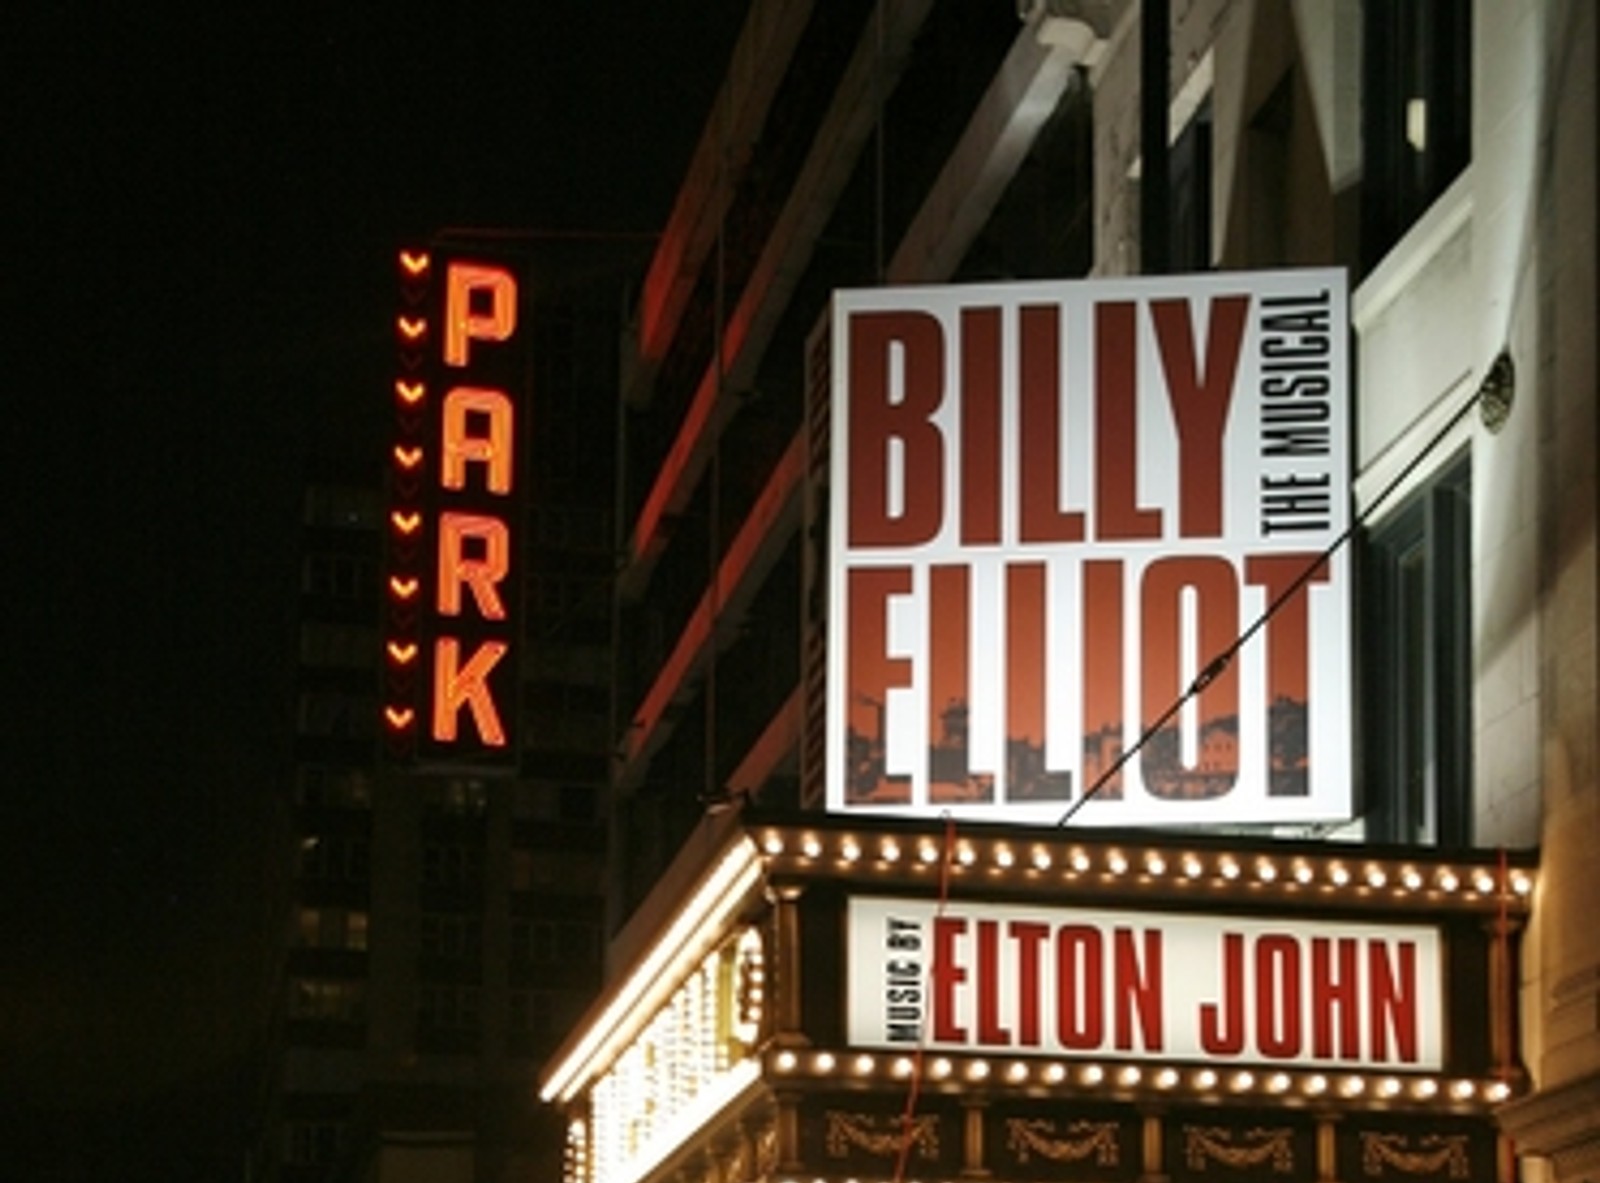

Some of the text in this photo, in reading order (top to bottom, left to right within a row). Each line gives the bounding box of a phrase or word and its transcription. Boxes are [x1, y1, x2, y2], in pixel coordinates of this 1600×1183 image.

[432, 261, 518, 747] PARK
[847, 295, 1252, 549] BILLY
[1261, 288, 1331, 538] THE MUSICAL
[844, 552, 1332, 806] ELLIOT
[886, 917, 922, 1043] MUSIC BY
[932, 916, 1419, 1064] ELTON JOHN
